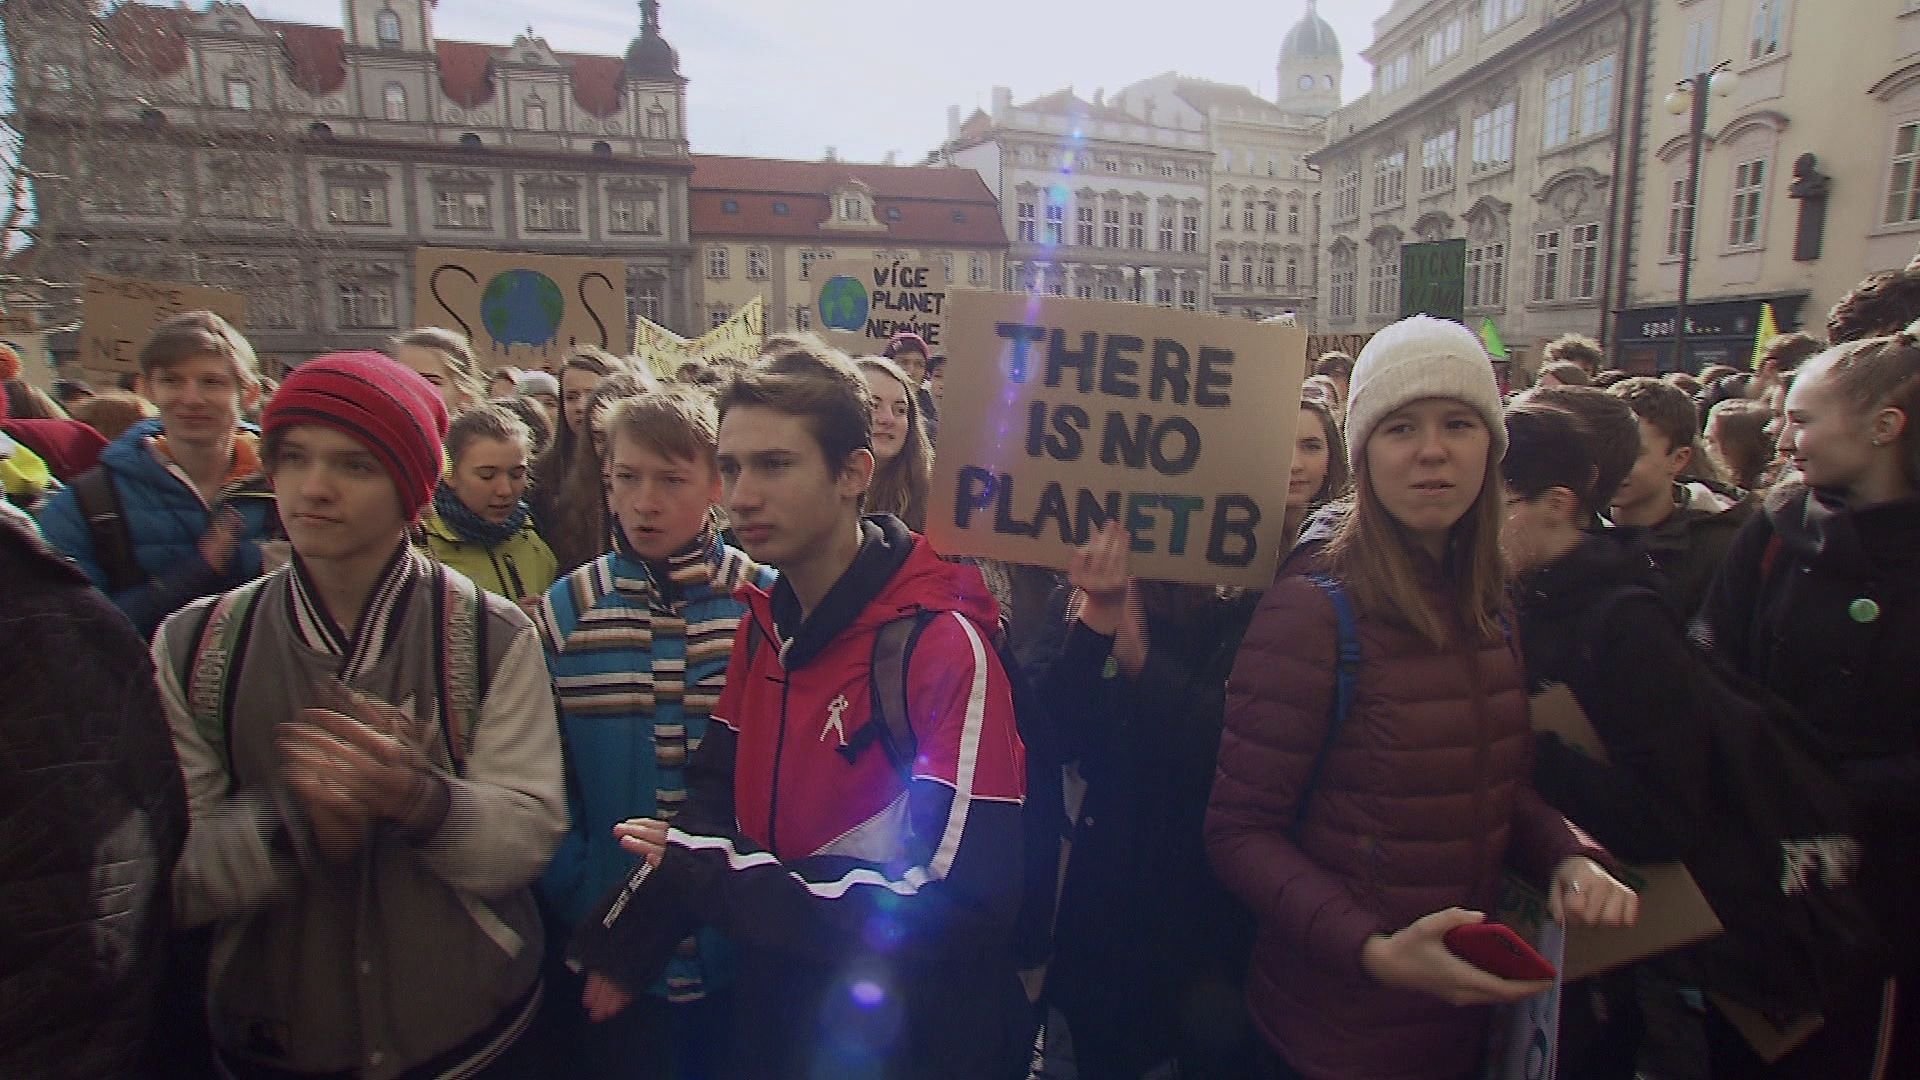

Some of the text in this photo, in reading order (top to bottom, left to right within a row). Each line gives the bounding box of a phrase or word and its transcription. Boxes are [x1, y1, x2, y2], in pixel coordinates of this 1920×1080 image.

[873, 260, 929, 288] VÍCE
[872, 290, 946, 315] PLANET
[92, 336, 135, 362] NE
[995, 321, 1237, 409] THERE
[1024, 400, 1201, 476] IS NO
[953, 464, 1262, 568] PLANET B
